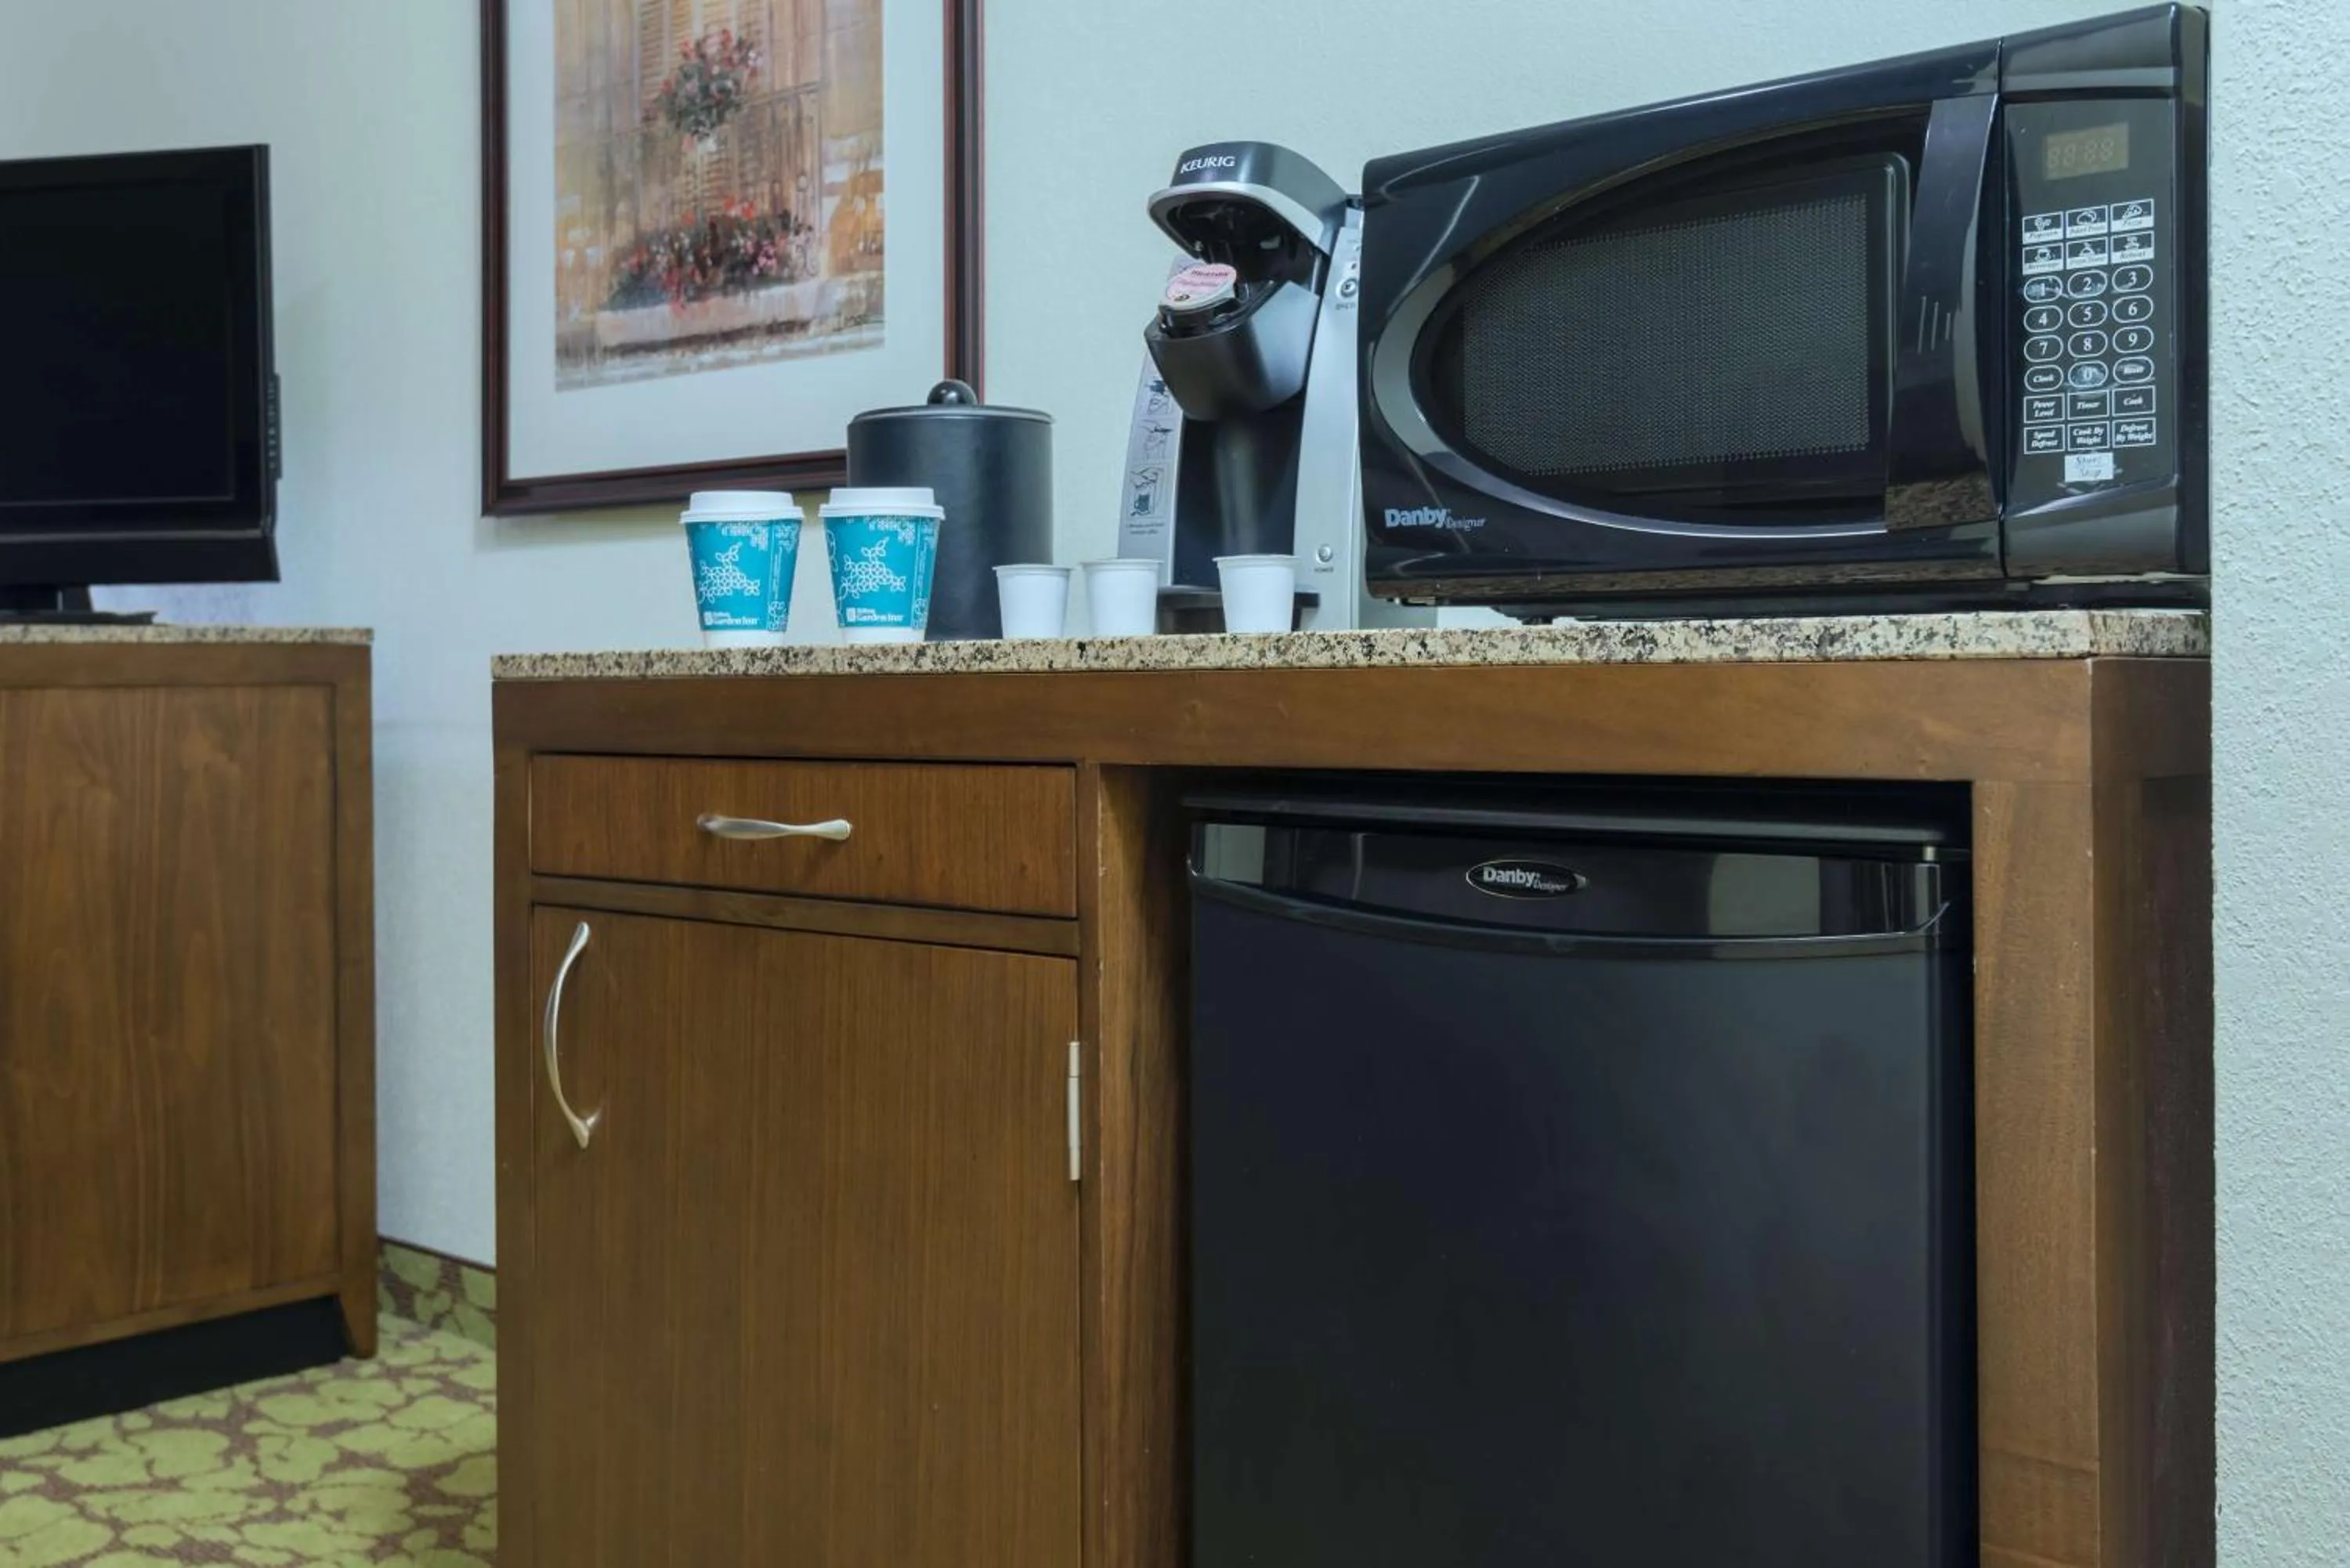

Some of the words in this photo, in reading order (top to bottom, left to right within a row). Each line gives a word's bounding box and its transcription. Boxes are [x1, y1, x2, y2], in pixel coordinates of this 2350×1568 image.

[1180, 156, 1235, 174] KEURIG
[2083, 276, 2092, 291] 2
[2128, 271, 2137, 284] 3
[2083, 306, 2092, 321] 5
[2128, 302, 2138, 316] 6
[2038, 311, 2048, 326] 4
[2083, 337, 2092, 351] 8
[2128, 332, 2138, 346] 9
[2039, 340, 2048, 355] 7
[2083, 367, 2092, 381] 0
[1384, 506, 1447, 529] Danby
[1483, 866, 1535, 887] Danby
